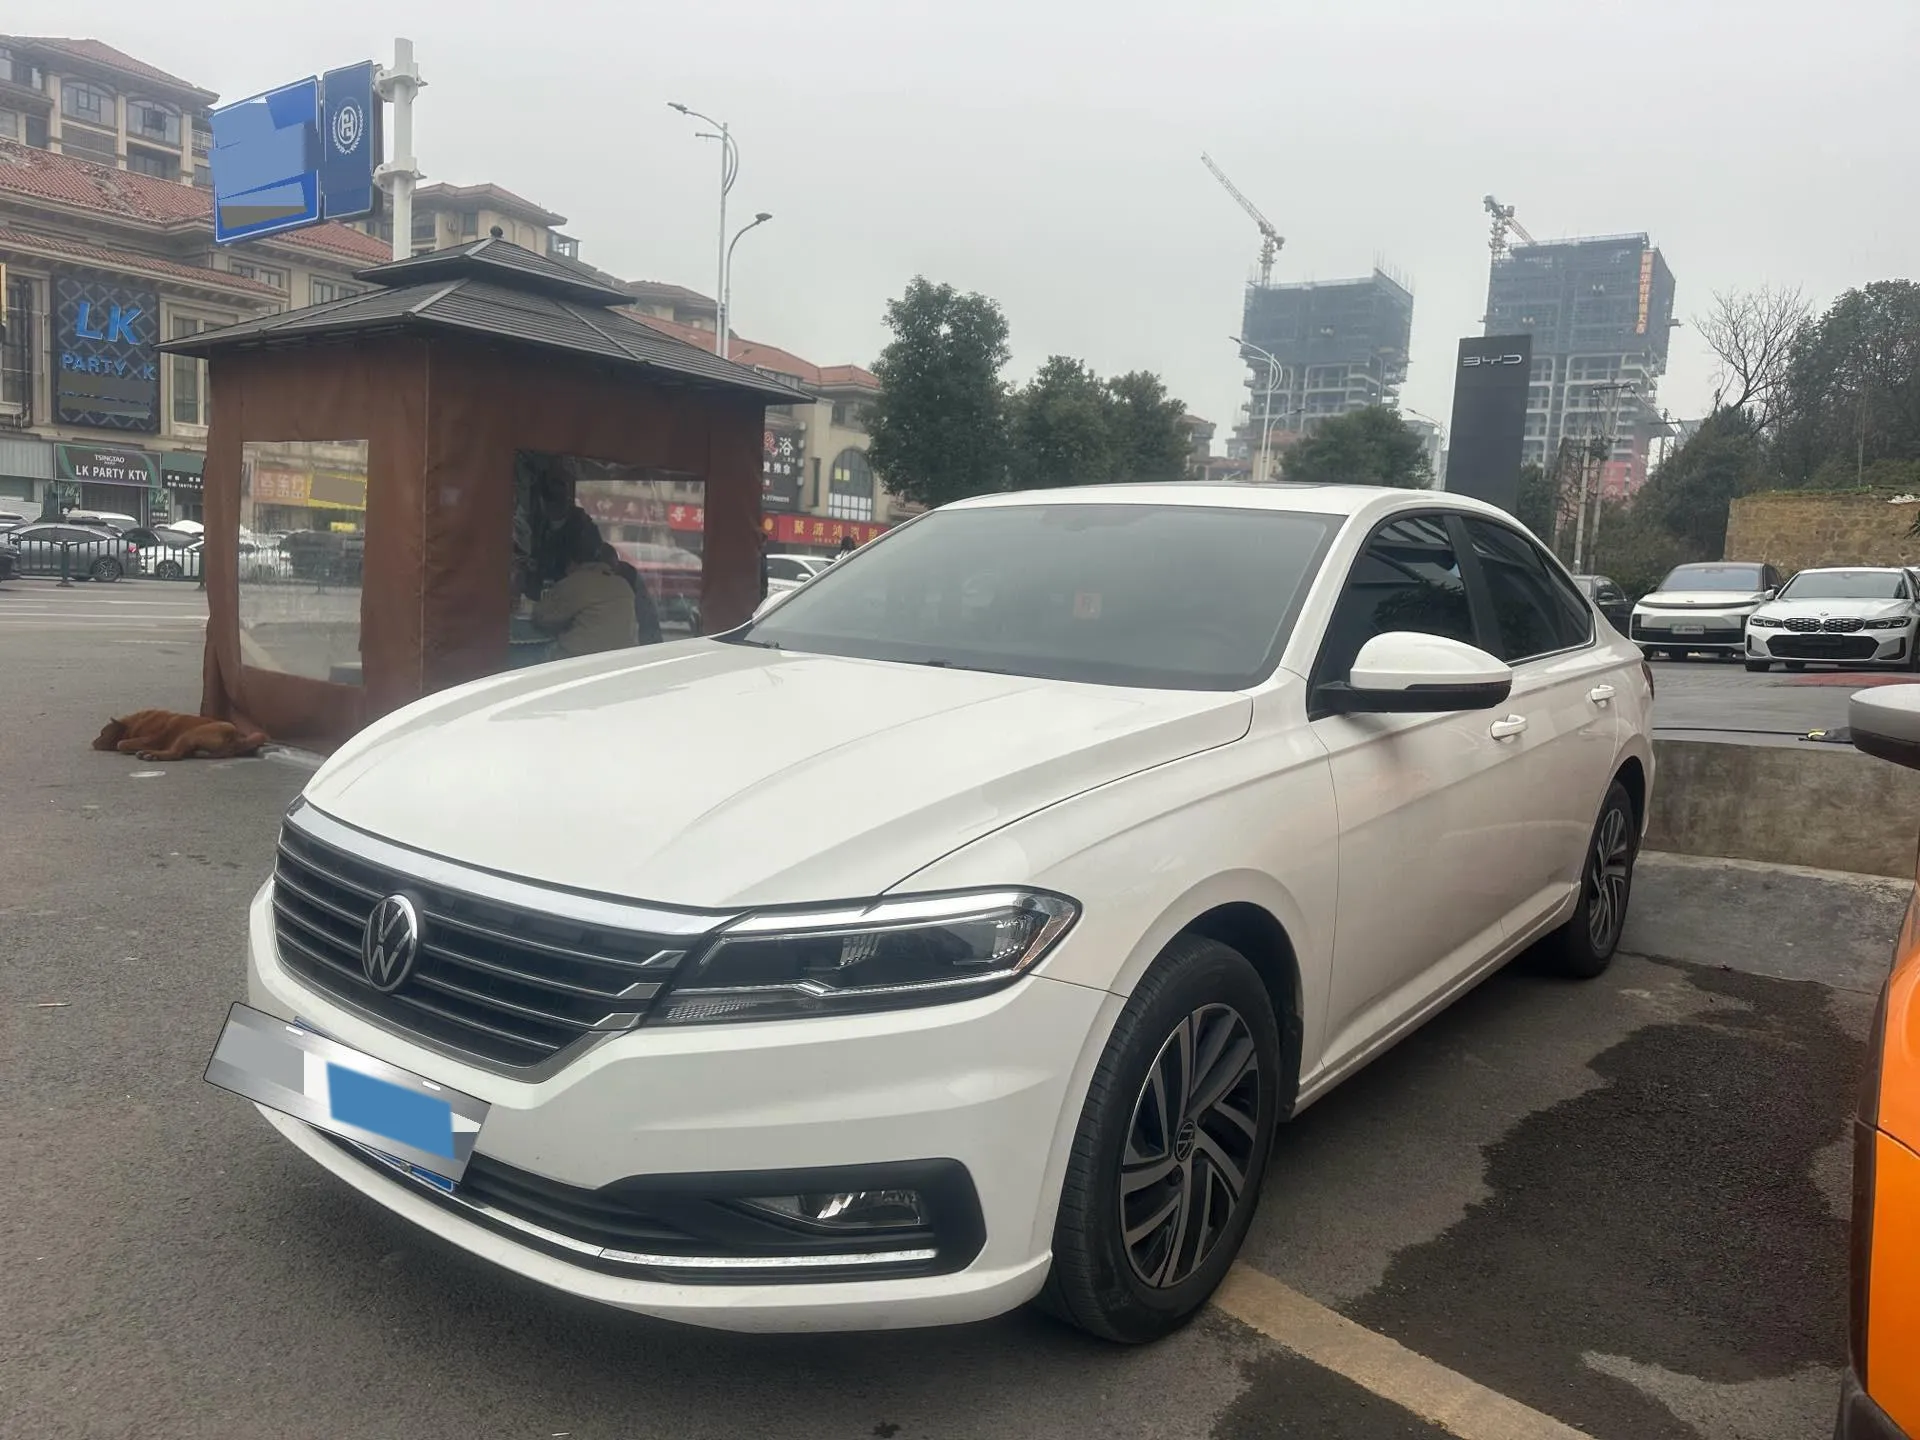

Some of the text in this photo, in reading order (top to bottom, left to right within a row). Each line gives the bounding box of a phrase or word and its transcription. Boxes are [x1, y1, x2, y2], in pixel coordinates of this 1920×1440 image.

[76, 302, 142, 345] LK
[62, 353, 126, 375] PARTY
[1463, 354, 1522, 367] BYD
[94, 454, 125, 464] TSINGTAO
[75, 464, 148, 481] LK PARTY KTV
